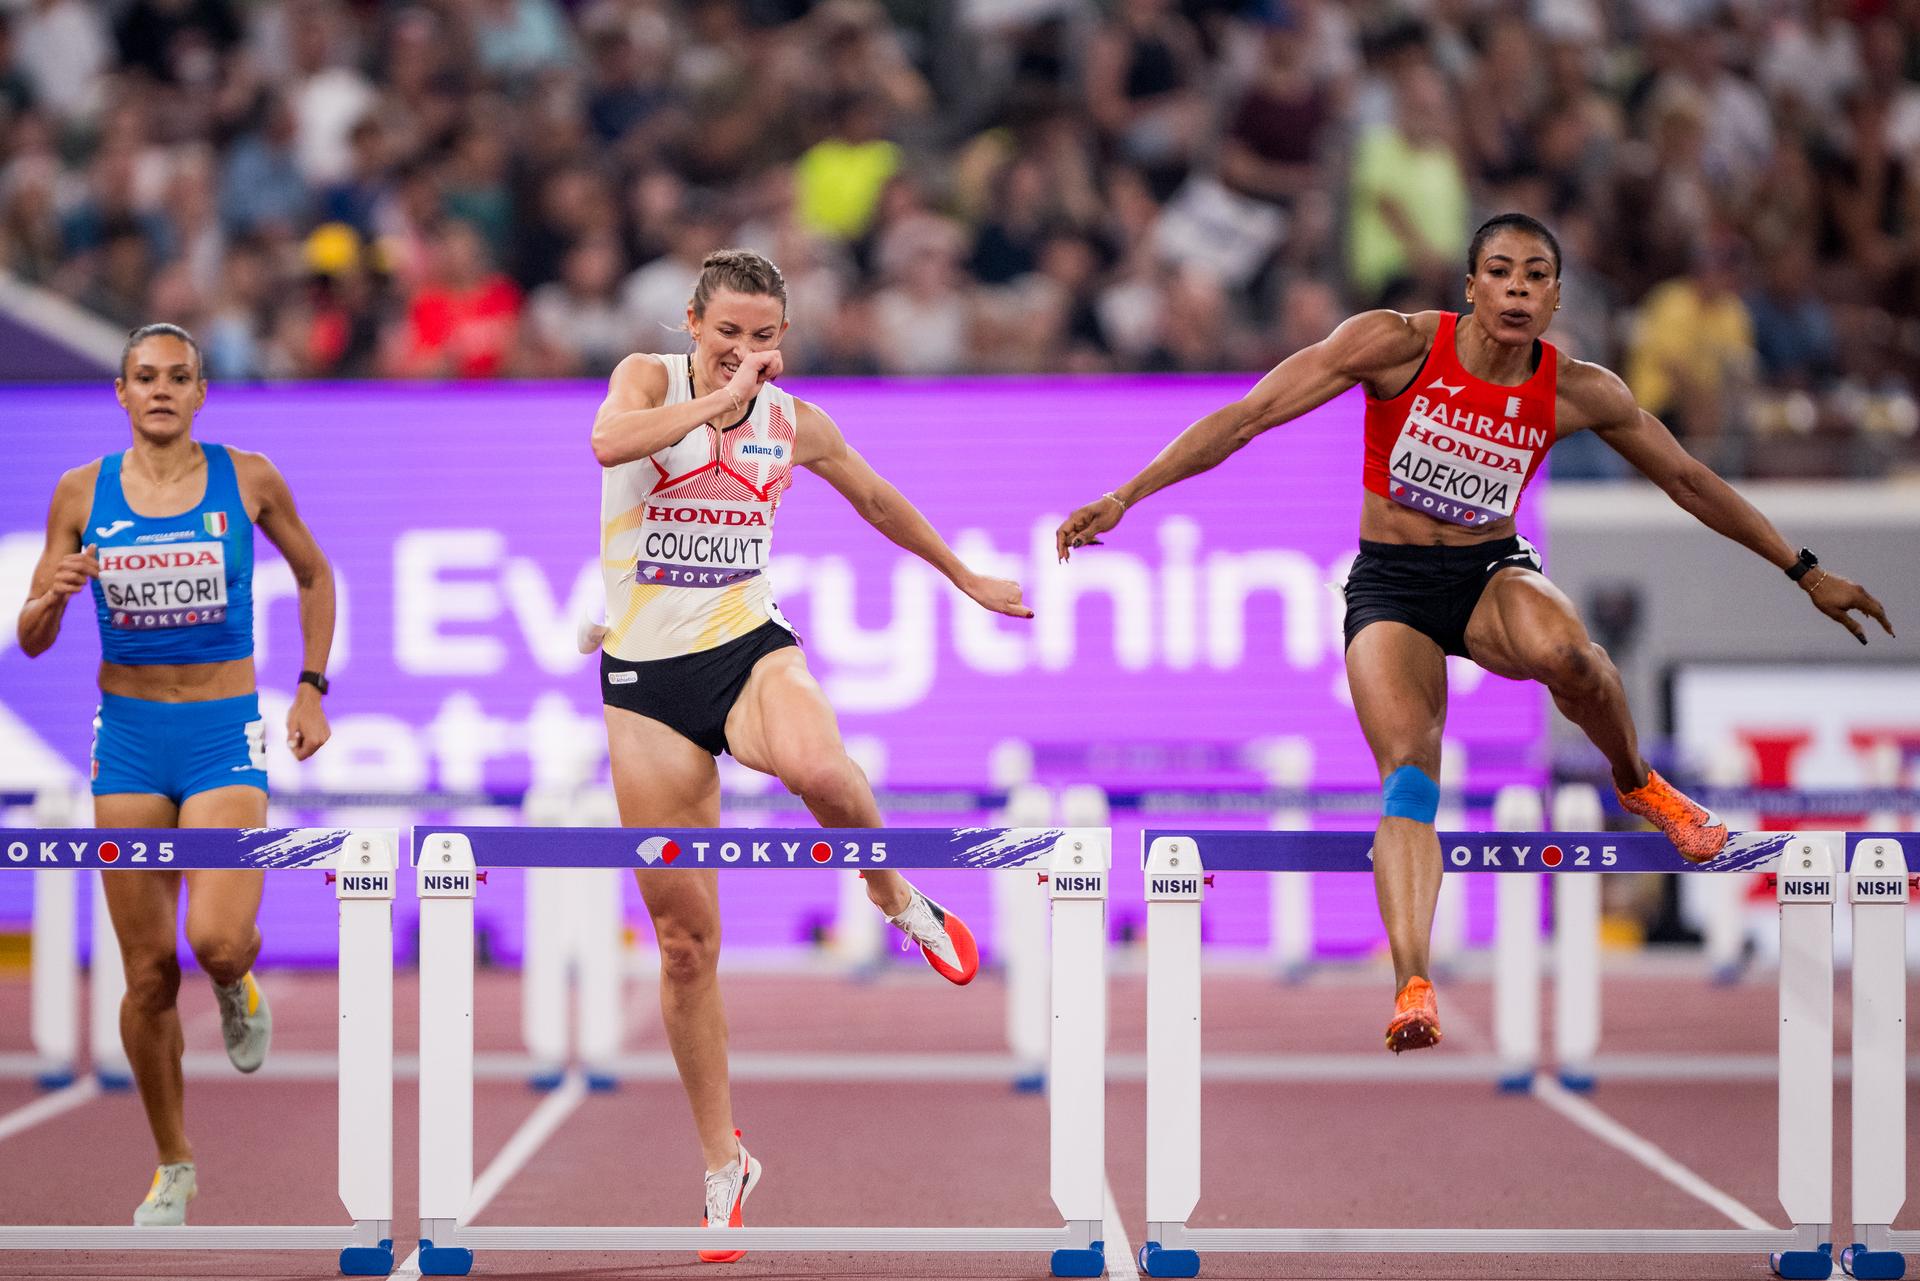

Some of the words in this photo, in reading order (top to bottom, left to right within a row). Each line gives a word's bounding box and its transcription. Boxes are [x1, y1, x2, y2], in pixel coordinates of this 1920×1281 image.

[1409, 394, 1548, 449] BAHRAIN
[741, 444, 772, 456] Allianz
[1404, 420, 1524, 475] HONDA
[1392, 451, 1509, 510] ADEKOYA
[646, 505, 767, 527] HONDA
[645, 532, 763, 565] COUCKUYT
[101, 550, 219, 572] HONDA
[107, 577, 219, 608] SARTORI
[343, 876, 389, 892] NISHI
[424, 875, 470, 891] NISHI
[1055, 876, 1102, 892] NISHI
[1152, 879, 1199, 895] NISHI
[1784, 880, 1831, 896] NISHI
[1856, 880, 1903, 896] NISHI
